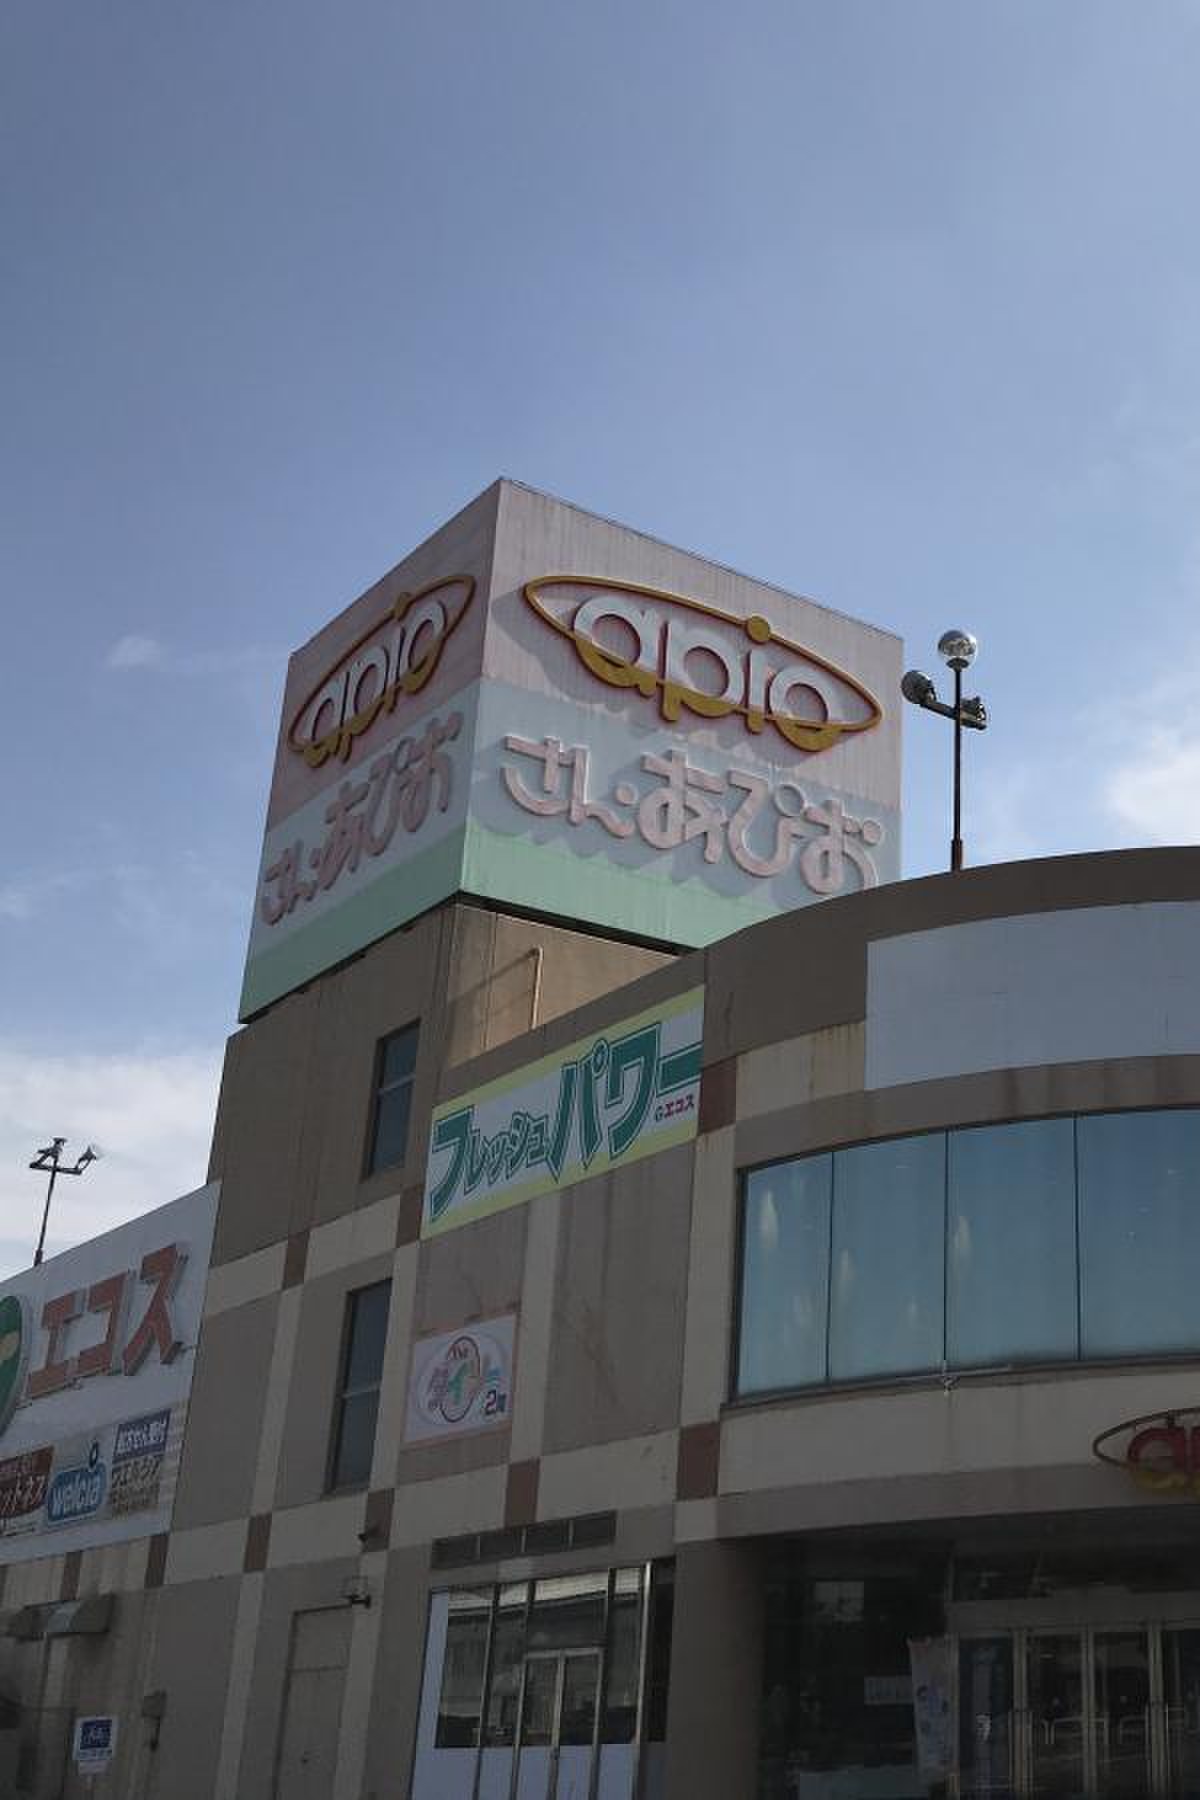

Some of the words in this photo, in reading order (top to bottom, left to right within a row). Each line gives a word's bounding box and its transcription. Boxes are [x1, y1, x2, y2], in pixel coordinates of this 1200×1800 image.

[303, 597, 447, 768] apio
[571, 594, 842, 752] apio
[430, 1022, 703, 1224] フレッシュパワー
[28, 1242, 185, 1398] エコス
